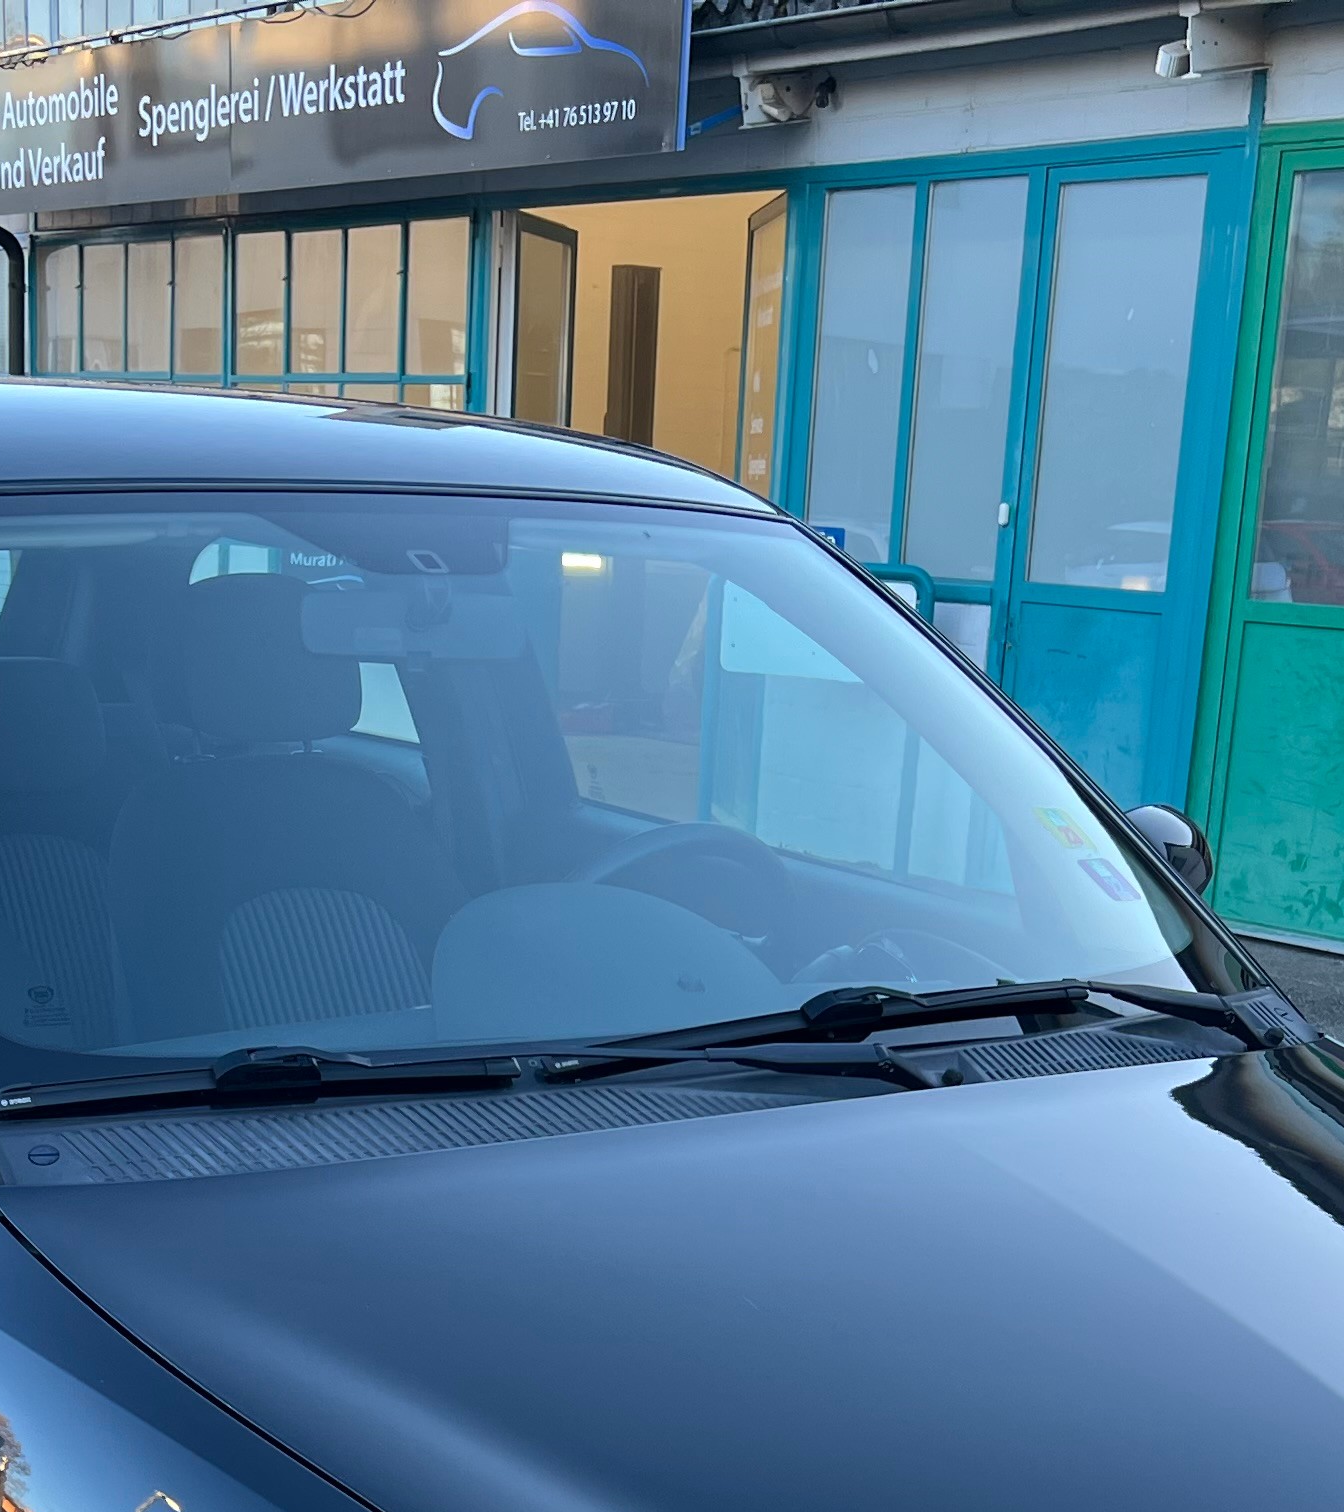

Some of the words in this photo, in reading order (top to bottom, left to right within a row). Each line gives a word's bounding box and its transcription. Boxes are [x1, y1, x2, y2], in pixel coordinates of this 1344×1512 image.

[2, 73, 119, 130] Automobile
[138, 77, 259, 146] Spenglerei
[278, 60, 406, 117] Werkstatt
[538, 108, 559, 129] +41
[562, 106, 578, 127] 76
[579, 103, 601, 125] 513
[603, 101, 618, 123] 97
[621, 99, 636, 121] 10
[28, 136, 106, 187] Verkauf
